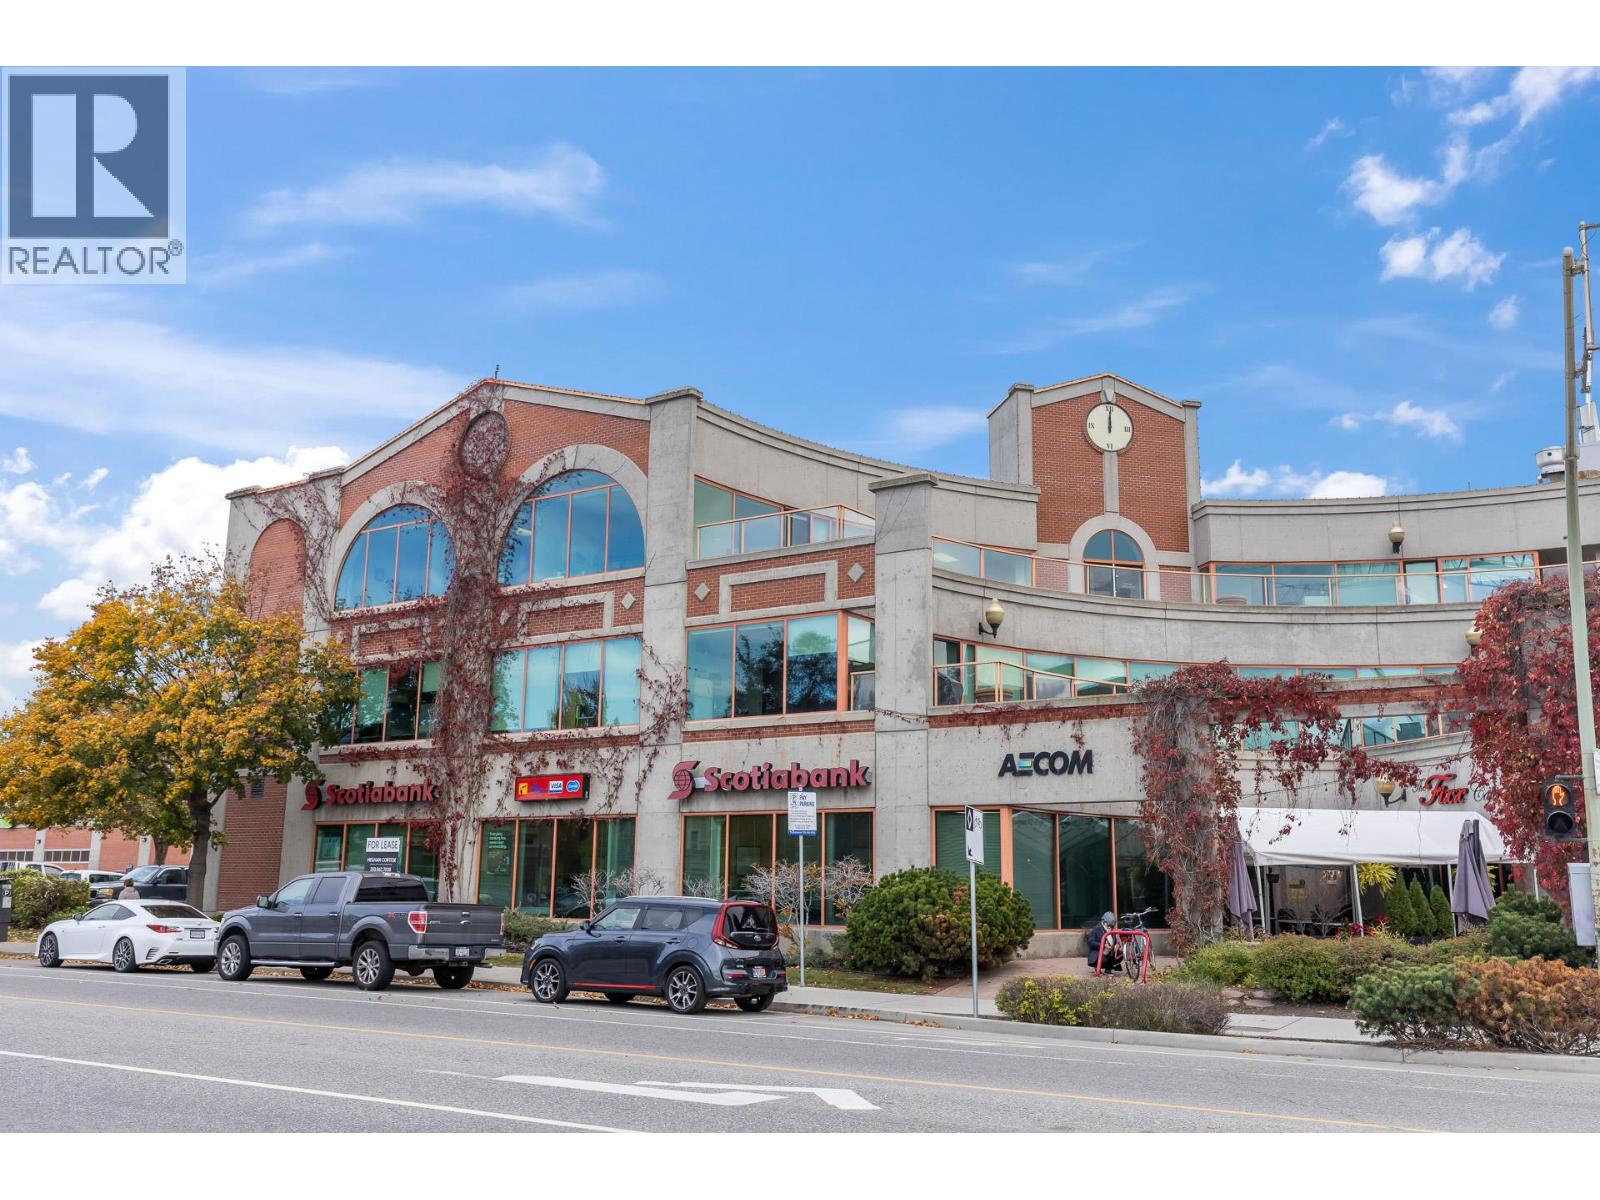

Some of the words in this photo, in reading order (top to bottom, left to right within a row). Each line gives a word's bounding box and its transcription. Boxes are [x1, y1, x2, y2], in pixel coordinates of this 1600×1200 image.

[704, 759, 867, 792] Scotiabank
[998, 749, 1093, 777] AECOM
[326, 778, 437, 806] Scotiabank
[367, 840, 379, 849] FOR
[380, 840, 398, 849] LEASE
